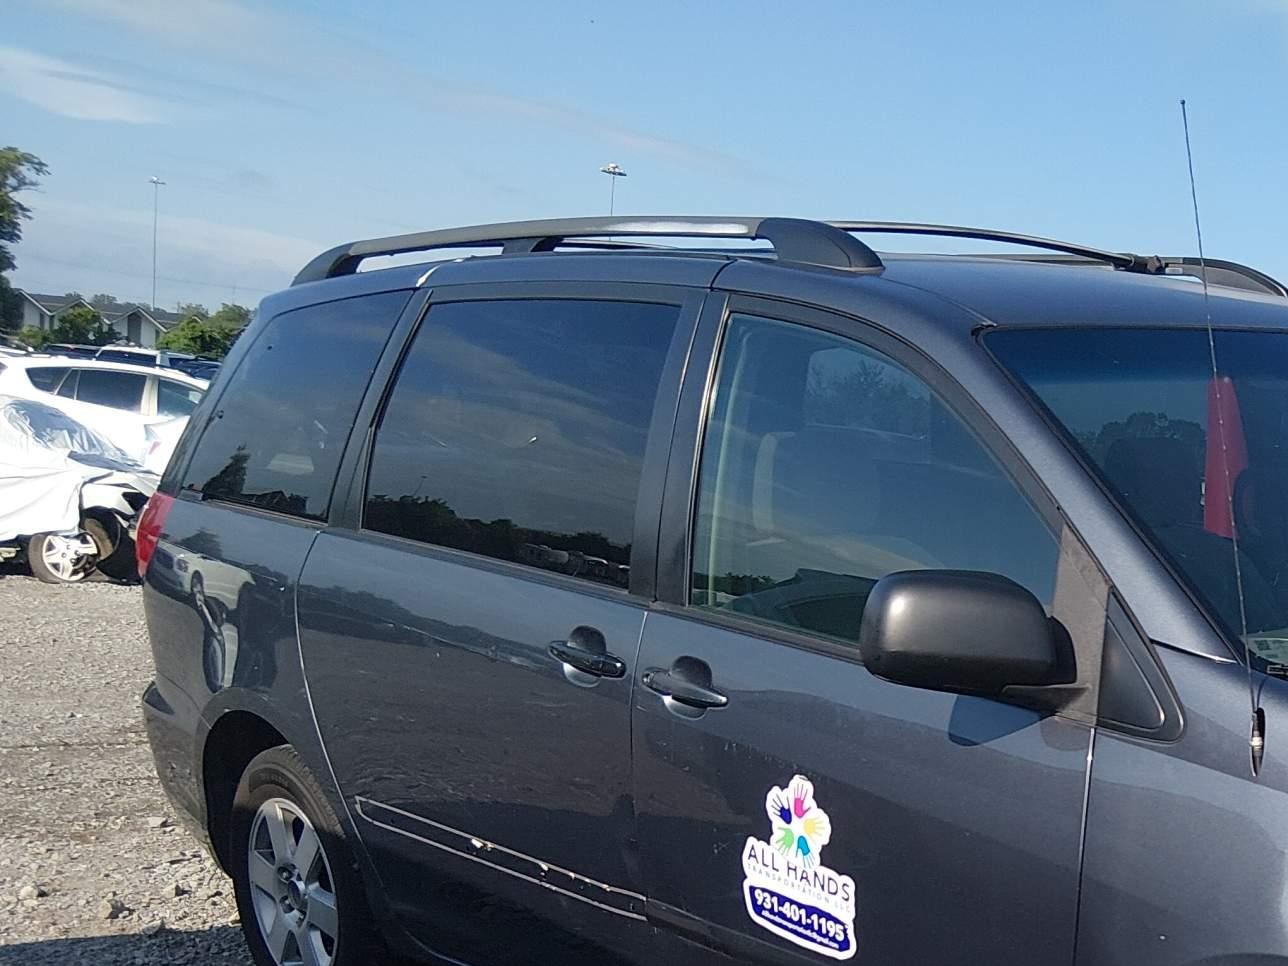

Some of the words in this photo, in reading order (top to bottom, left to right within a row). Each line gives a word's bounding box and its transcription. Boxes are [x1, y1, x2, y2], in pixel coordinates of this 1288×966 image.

[747, 843, 780, 873] ALL
[786, 860, 850, 902] HANDS
[754, 888, 845, 942] 931-401-1195
